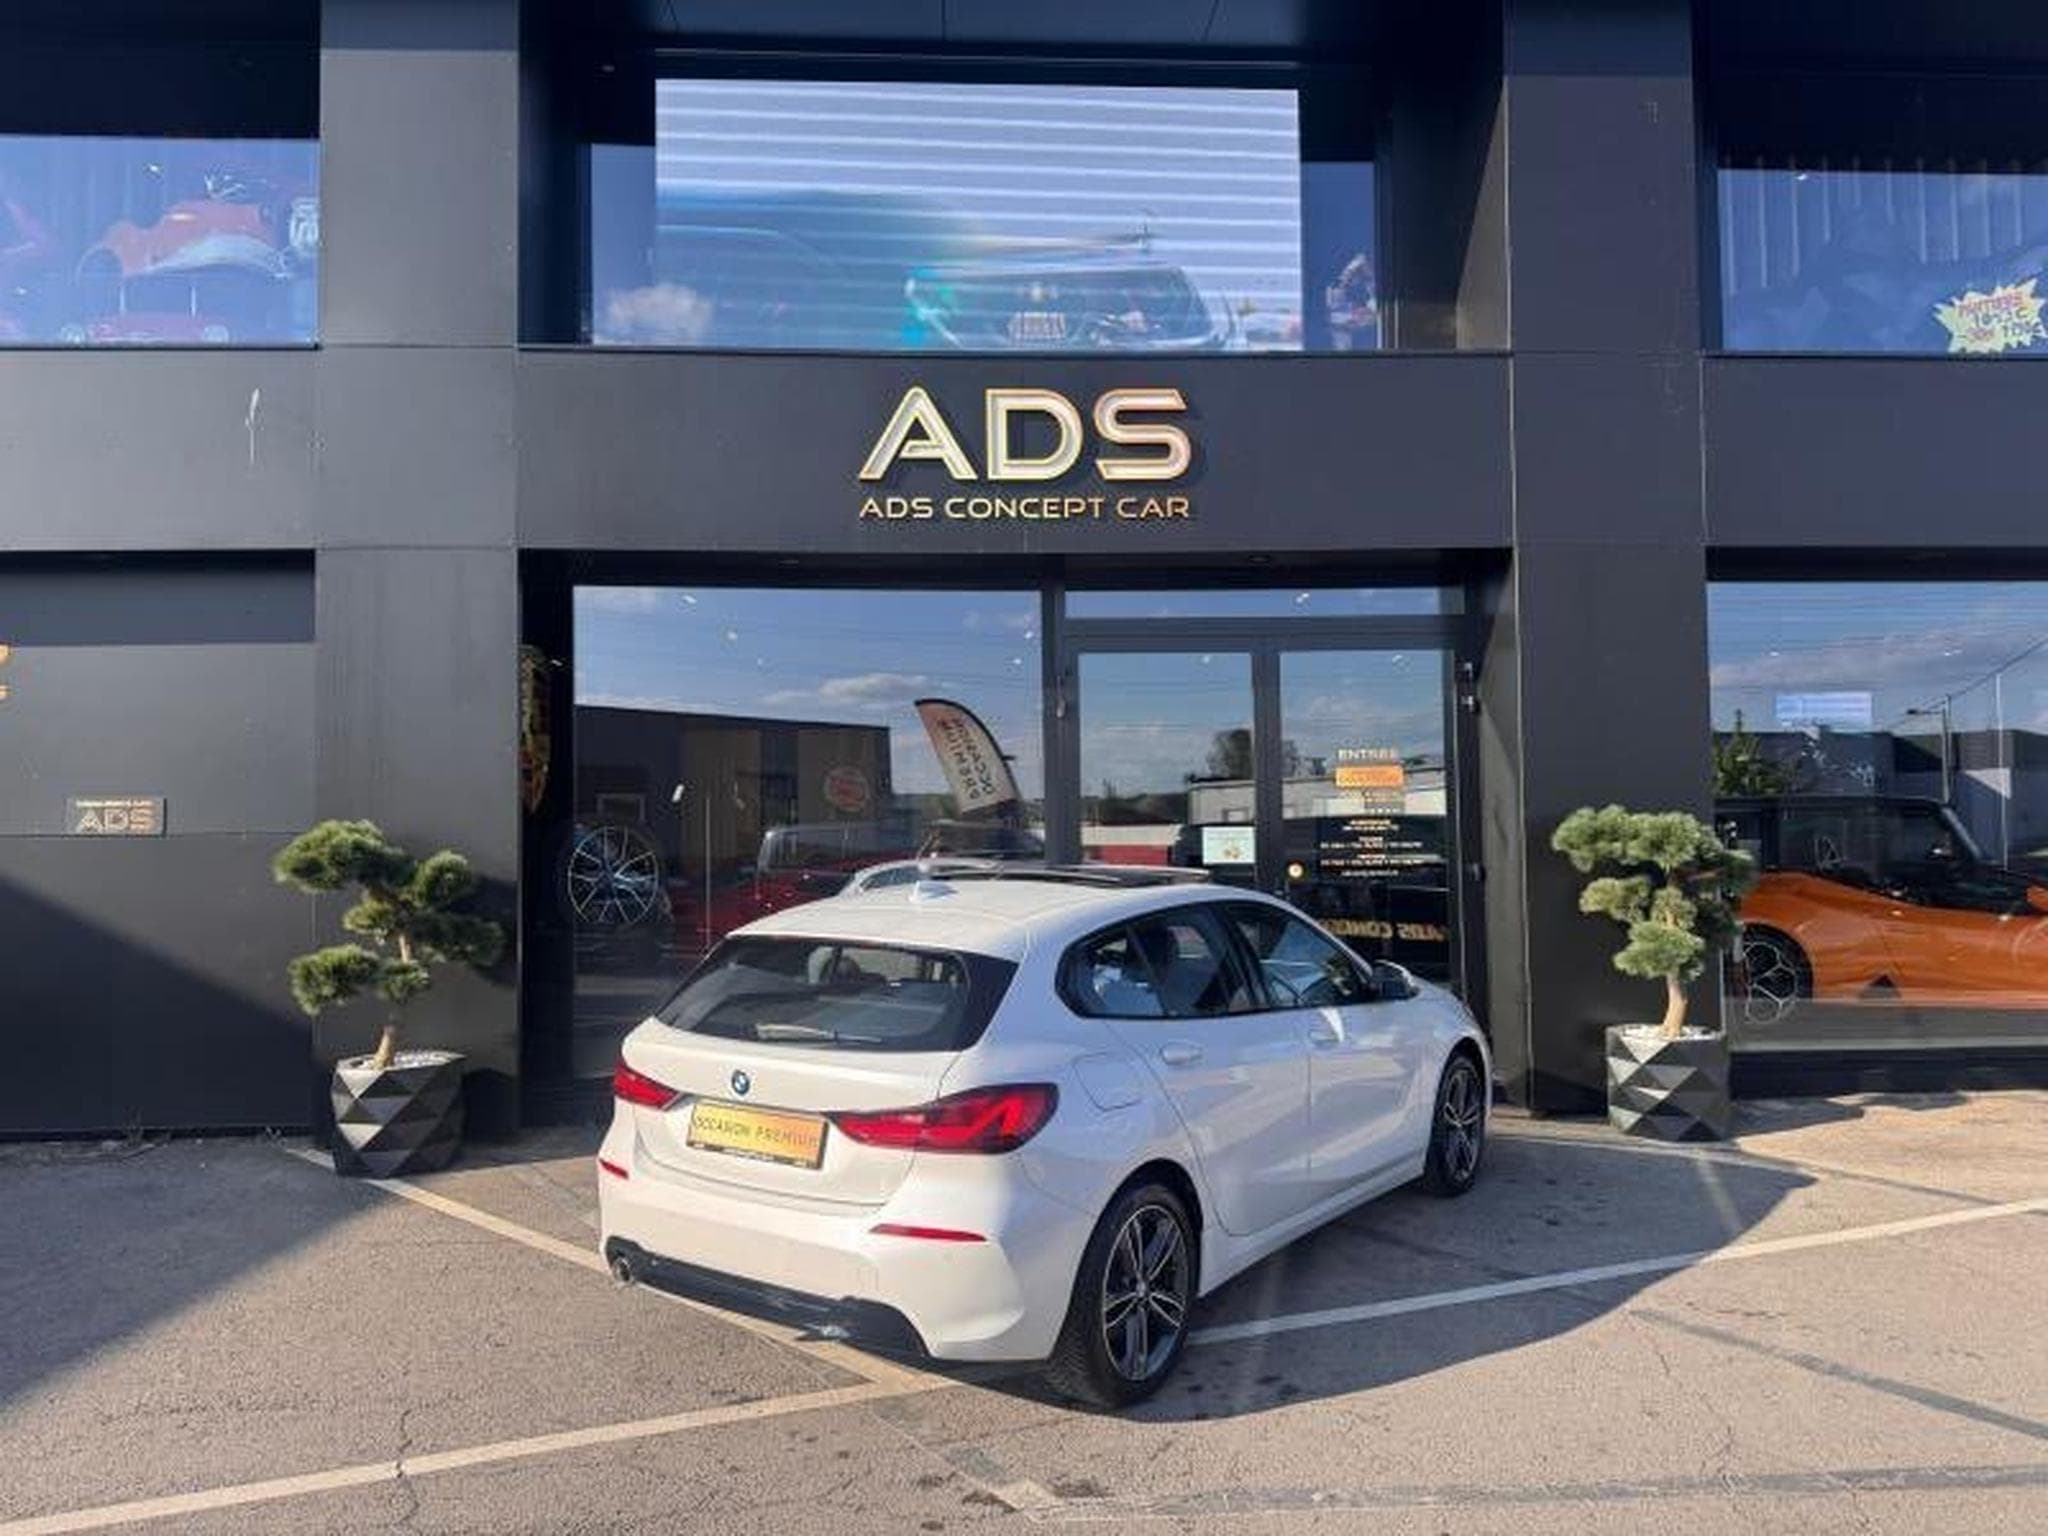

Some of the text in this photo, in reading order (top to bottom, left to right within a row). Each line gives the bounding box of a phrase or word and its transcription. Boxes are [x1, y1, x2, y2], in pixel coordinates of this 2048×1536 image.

[858, 386, 1191, 480] ADS
[859, 498, 1189, 519] ADS CONCEPT CAR
[76, 808, 155, 833] ADS
[693, 1115, 819, 1148] OCCASION PREMIUM
